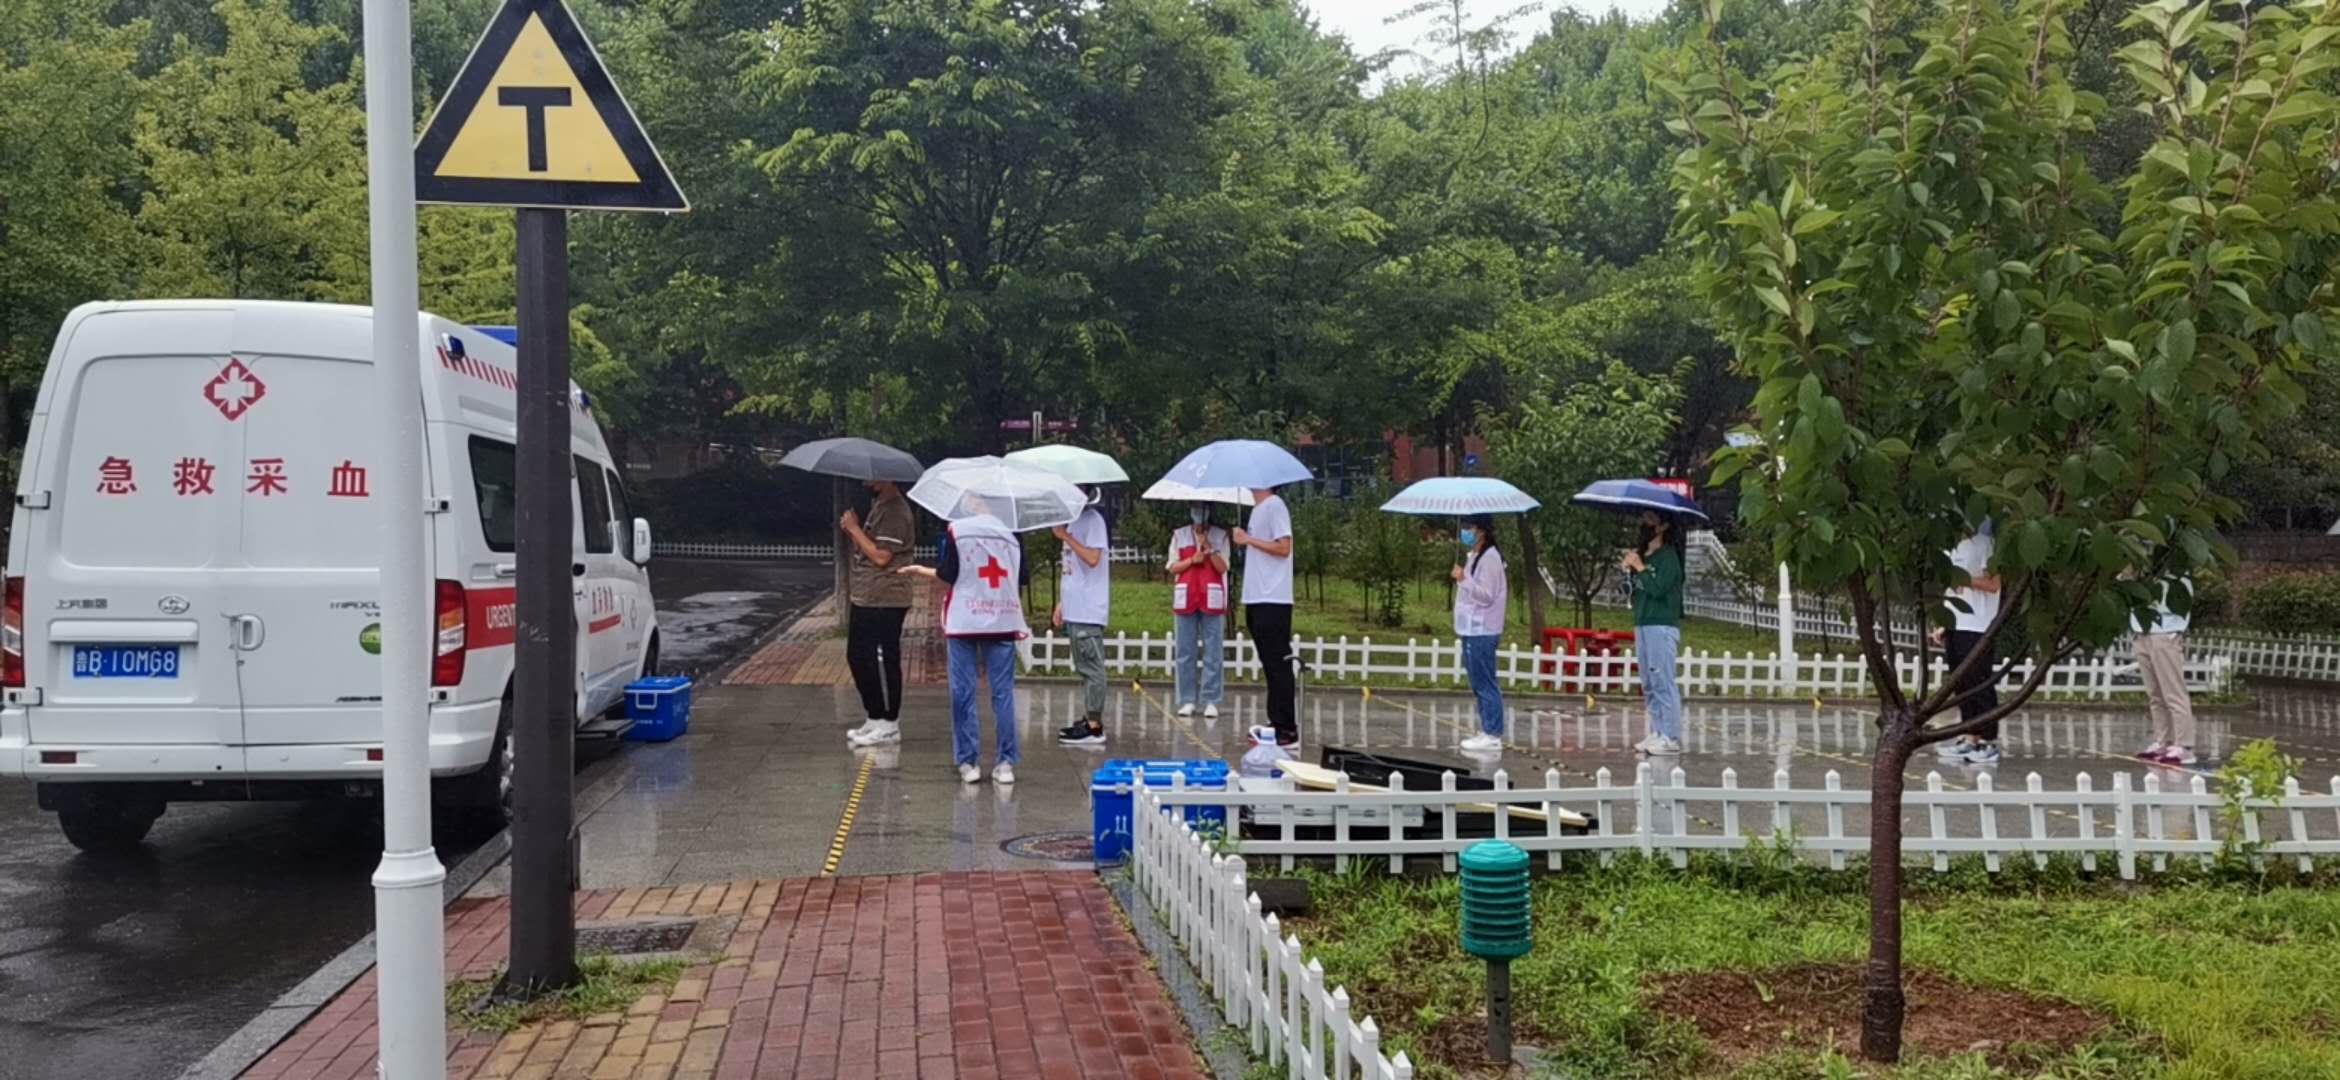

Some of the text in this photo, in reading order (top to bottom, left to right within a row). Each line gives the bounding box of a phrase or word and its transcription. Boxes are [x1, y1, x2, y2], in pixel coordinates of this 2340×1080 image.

[96, 456, 370, 497] 急救采血
[486, 603, 516, 629] URGEN
